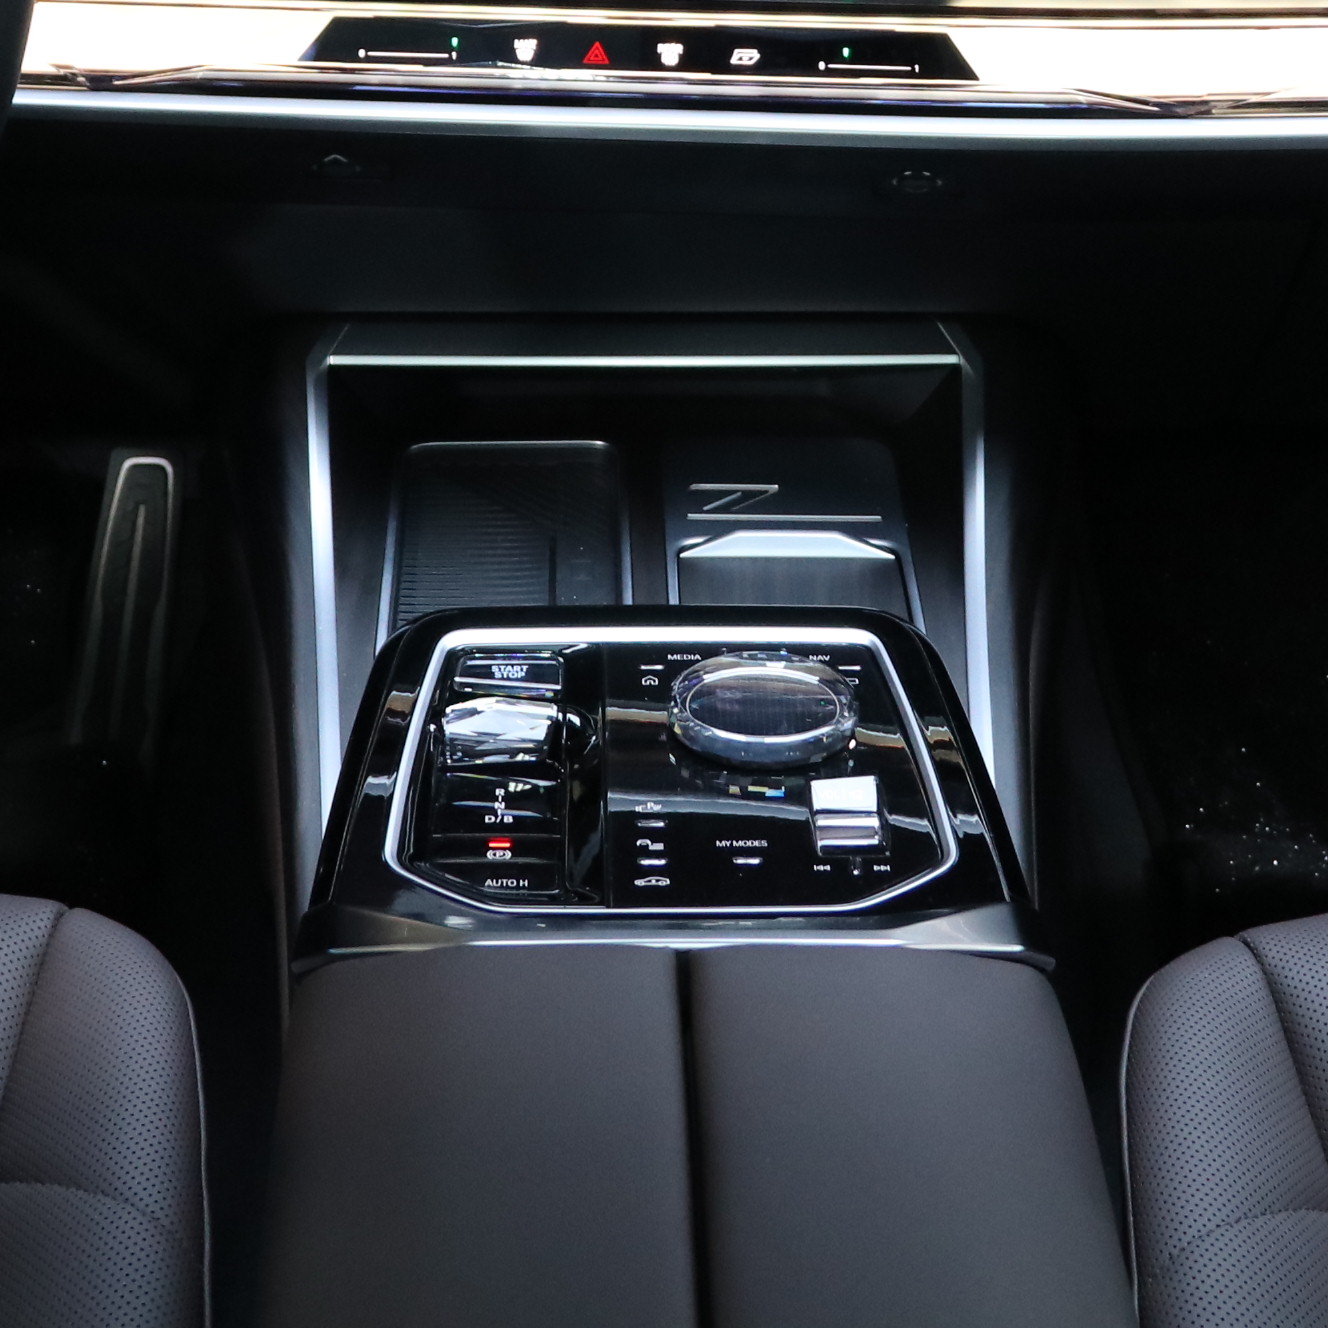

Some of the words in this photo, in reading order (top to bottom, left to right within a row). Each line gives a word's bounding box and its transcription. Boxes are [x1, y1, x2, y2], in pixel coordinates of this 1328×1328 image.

[667, 653, 702, 661] MEDIA
[809, 654, 830, 662] NAV
[491, 664, 528, 673] START
[494, 671, 526, 679] STOP
[715, 839, 731, 847] MY
[732, 839, 768, 847] MODES
[485, 878, 516, 888] AUTO
[519, 878, 529, 888] H
